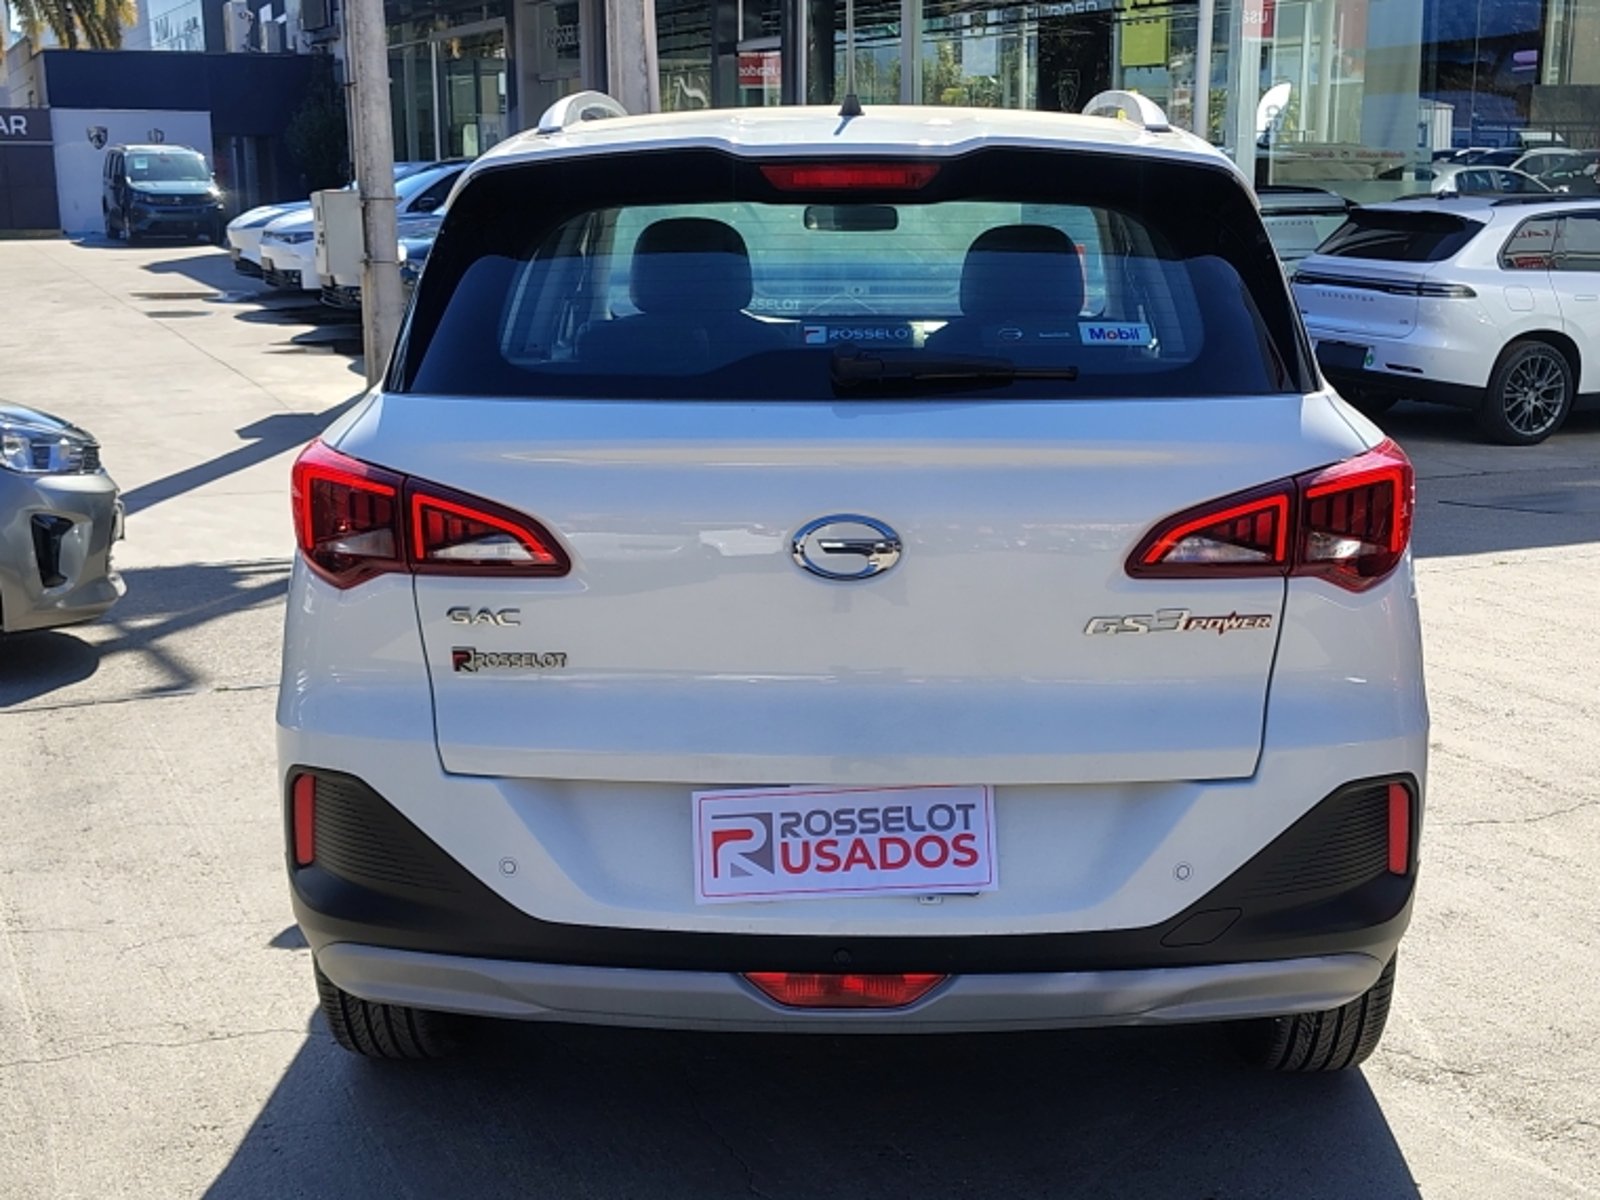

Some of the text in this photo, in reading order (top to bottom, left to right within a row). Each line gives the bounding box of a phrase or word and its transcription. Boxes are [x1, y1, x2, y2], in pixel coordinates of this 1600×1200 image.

[749, 299, 800, 310] SSELOT
[829, 328, 908, 340] ROSSELO
[1088, 327, 1140, 340] Mobil
[446, 606, 520, 626] GAC
[475, 652, 567, 668] ROSSELOT
[780, 803, 976, 838] ROSSELOT
[780, 833, 979, 874] USADOS
